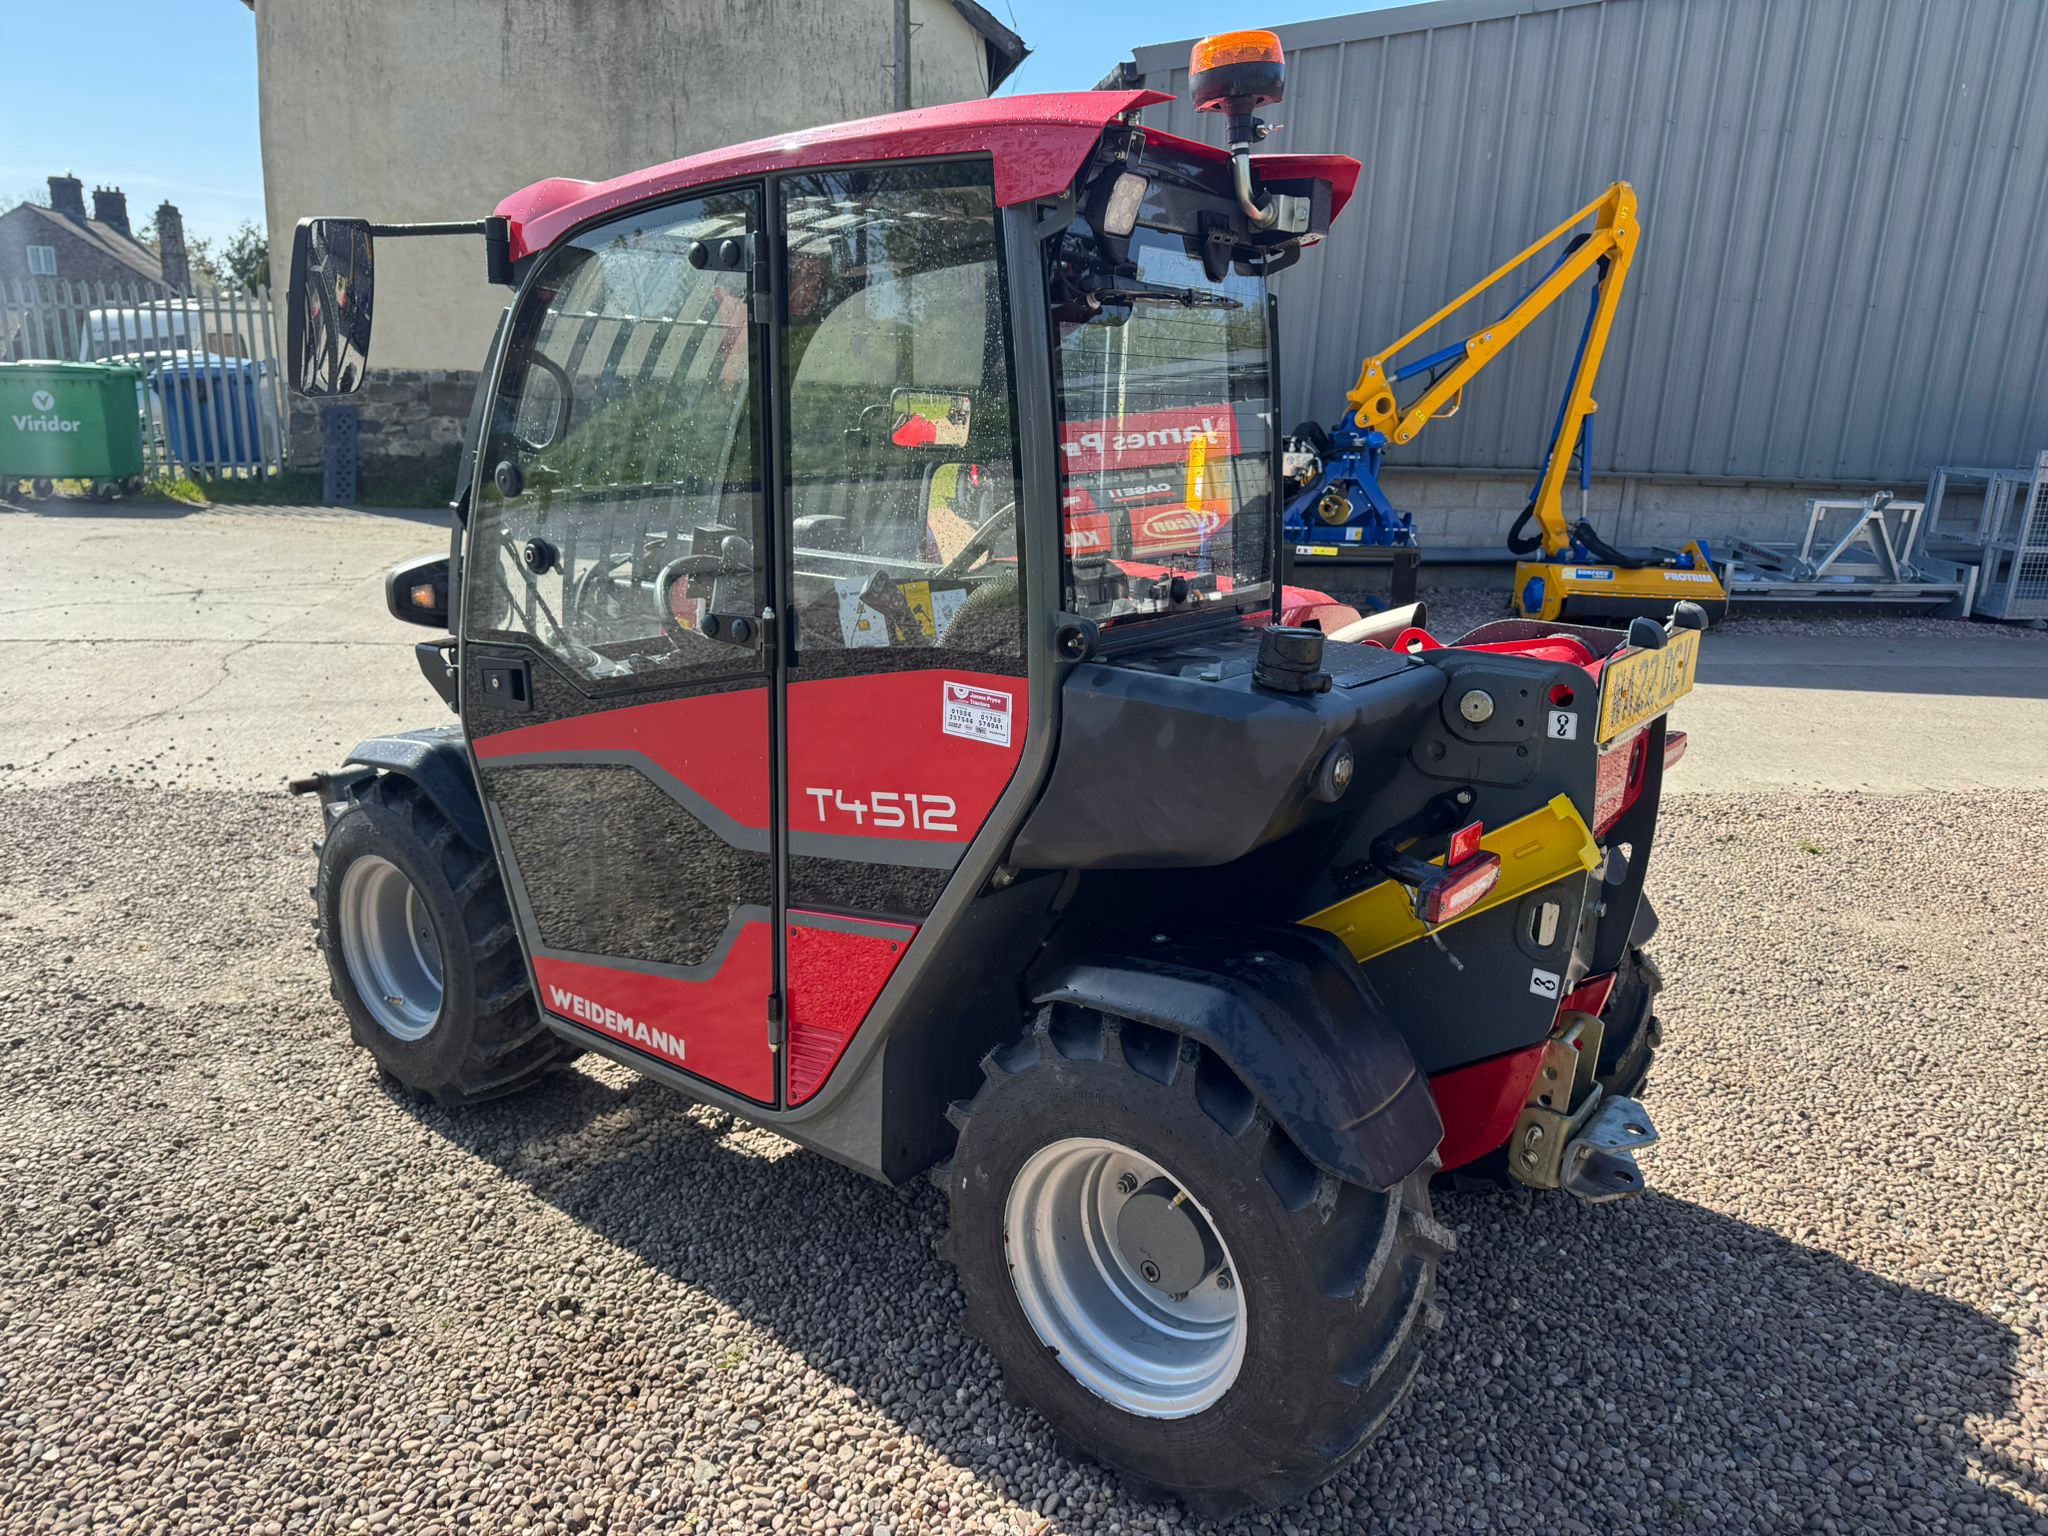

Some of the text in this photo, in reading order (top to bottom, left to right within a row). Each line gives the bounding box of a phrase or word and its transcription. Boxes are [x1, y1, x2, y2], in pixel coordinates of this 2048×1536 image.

[12, 414, 81, 432] Viridor
[1664, 571, 1714, 583] PROTRIM
[969, 693, 1002, 704] James Pryce
[969, 699, 991, 708] Tractors
[806, 787, 958, 832] T4512
[549, 984, 686, 1061] WEIDEMANN
